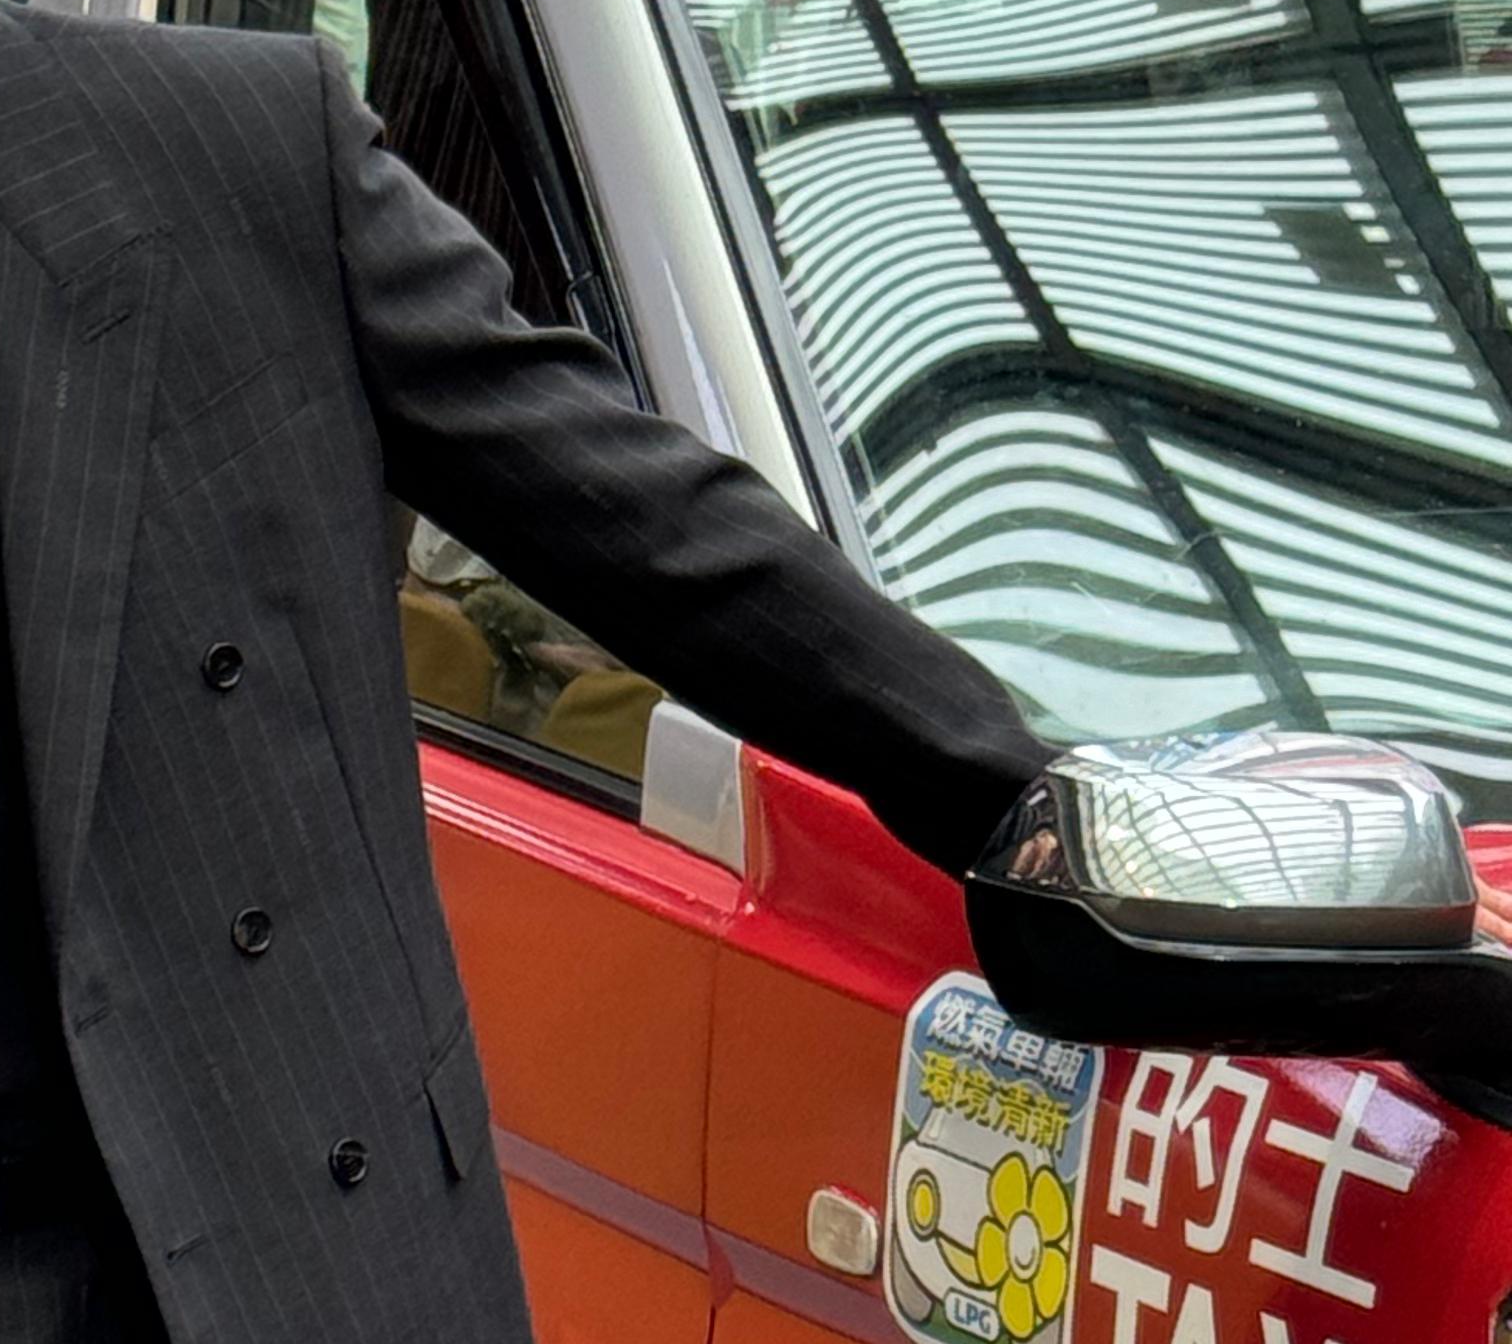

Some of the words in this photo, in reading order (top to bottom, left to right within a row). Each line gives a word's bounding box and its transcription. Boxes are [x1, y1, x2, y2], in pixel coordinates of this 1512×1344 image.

[920, 1050, 1070, 1157] 環境清新
[1106, 1052, 1416, 1310] 的士
[954, 1296, 992, 1335] LPG
